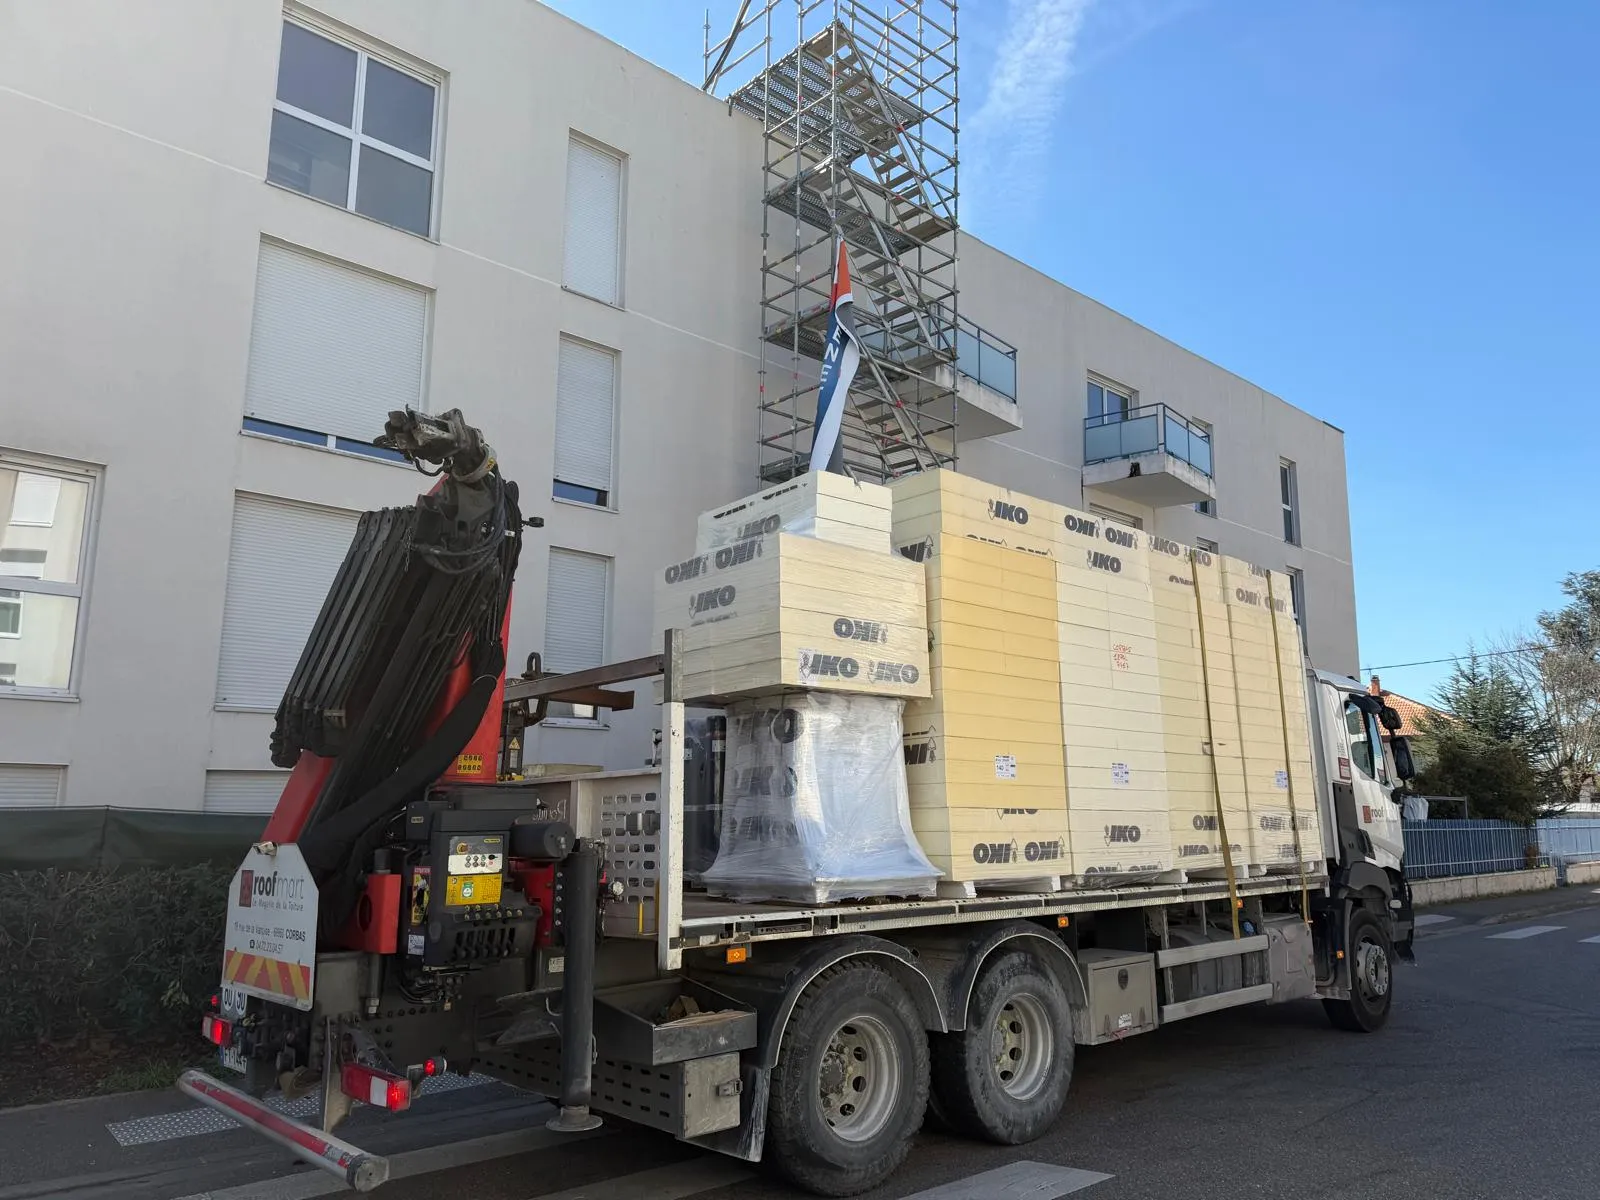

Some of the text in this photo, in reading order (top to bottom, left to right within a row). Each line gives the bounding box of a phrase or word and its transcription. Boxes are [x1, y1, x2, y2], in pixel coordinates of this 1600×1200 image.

[994, 500, 1029, 525] IKO
[743, 514, 781, 540] IKO
[1064, 515, 1133, 549] IKO IKO
[715, 538, 759, 569] IKO
[1154, 535, 1180, 557] IKO
[665, 556, 706, 584] IKO
[1093, 551, 1122, 573] IKO
[694, 585, 736, 614] IKO
[1236, 588, 1258, 605] IKO
[833, 617, 879, 643] IKO
[811, 653, 920, 685] IKO IKO
[1110, 825, 1141, 843] IKO
[973, 841, 1060, 864] IKO IKO
[253, 870, 305, 900] roofmart
[286, 929, 306, 942] CORBAS
